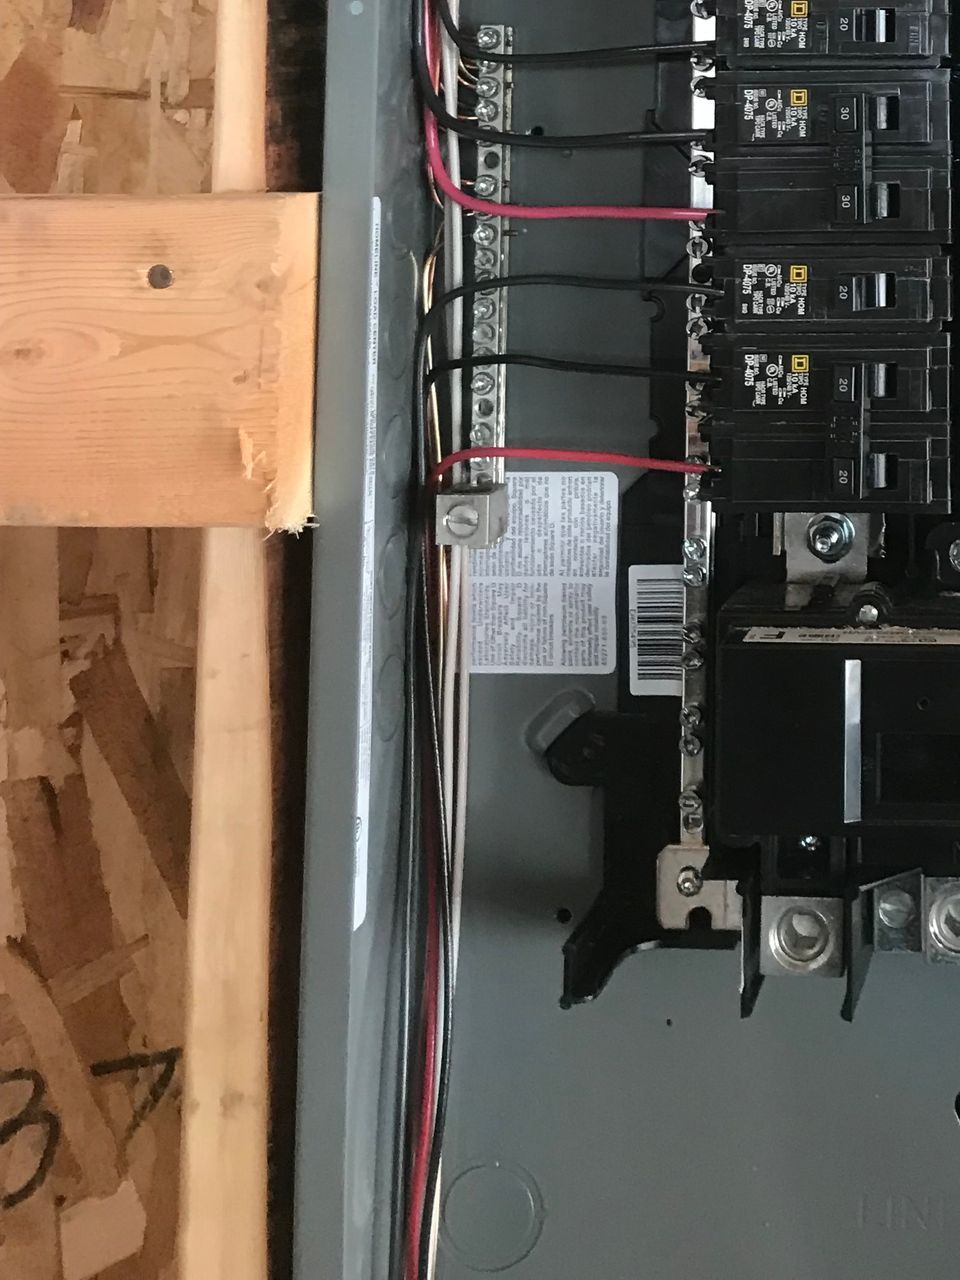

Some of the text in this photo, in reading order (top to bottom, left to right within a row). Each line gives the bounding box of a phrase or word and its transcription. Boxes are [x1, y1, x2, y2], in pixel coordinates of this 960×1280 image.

[840, 18, 848, 30] 20
[841, 108, 849, 119] 30
[842, 196, 850, 207] 30
[840, 286, 848, 299] 20
[839, 378, 848, 391] 20
[839, 470, 848, 483] 20
